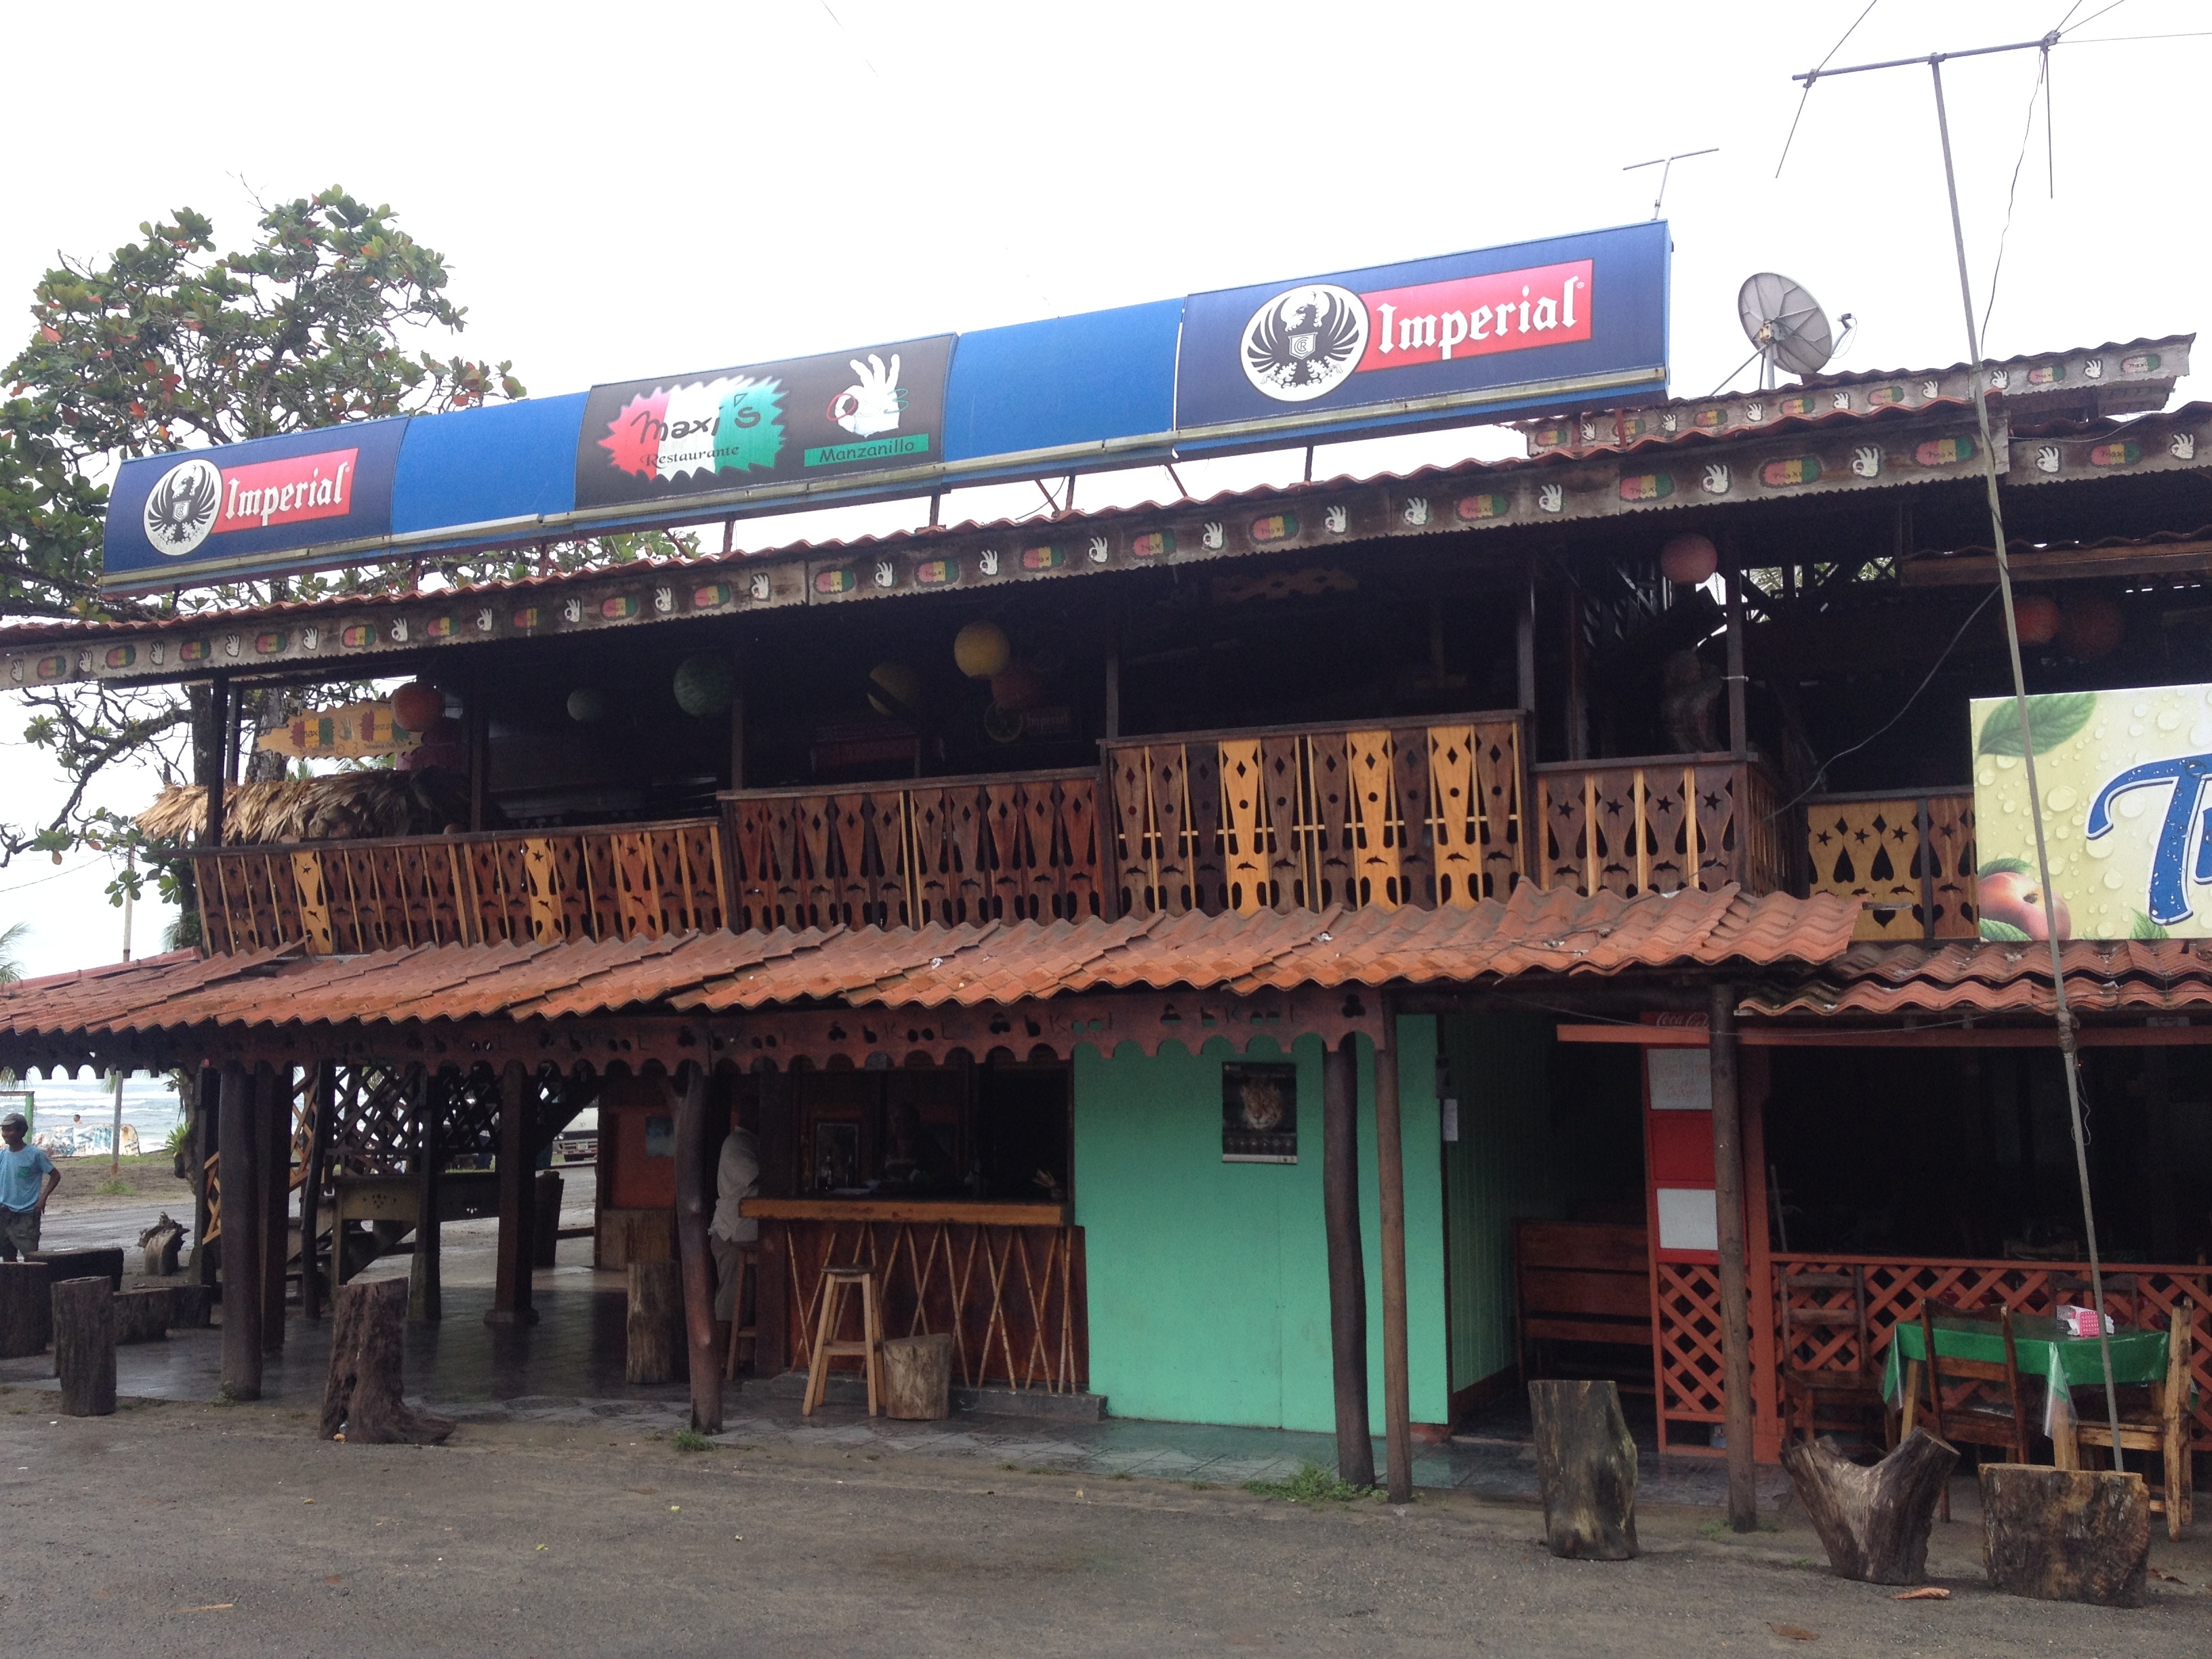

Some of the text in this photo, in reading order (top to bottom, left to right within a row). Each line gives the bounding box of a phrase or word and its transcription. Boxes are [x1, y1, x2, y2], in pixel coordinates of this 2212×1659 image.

[1376, 275, 1579, 360] Imperial
[640, 446, 740, 469] Restaurante
[819, 438, 915, 463] Manzanillo
[225, 461, 349, 527] Imperial
[2085, 753, 2212, 926] T
